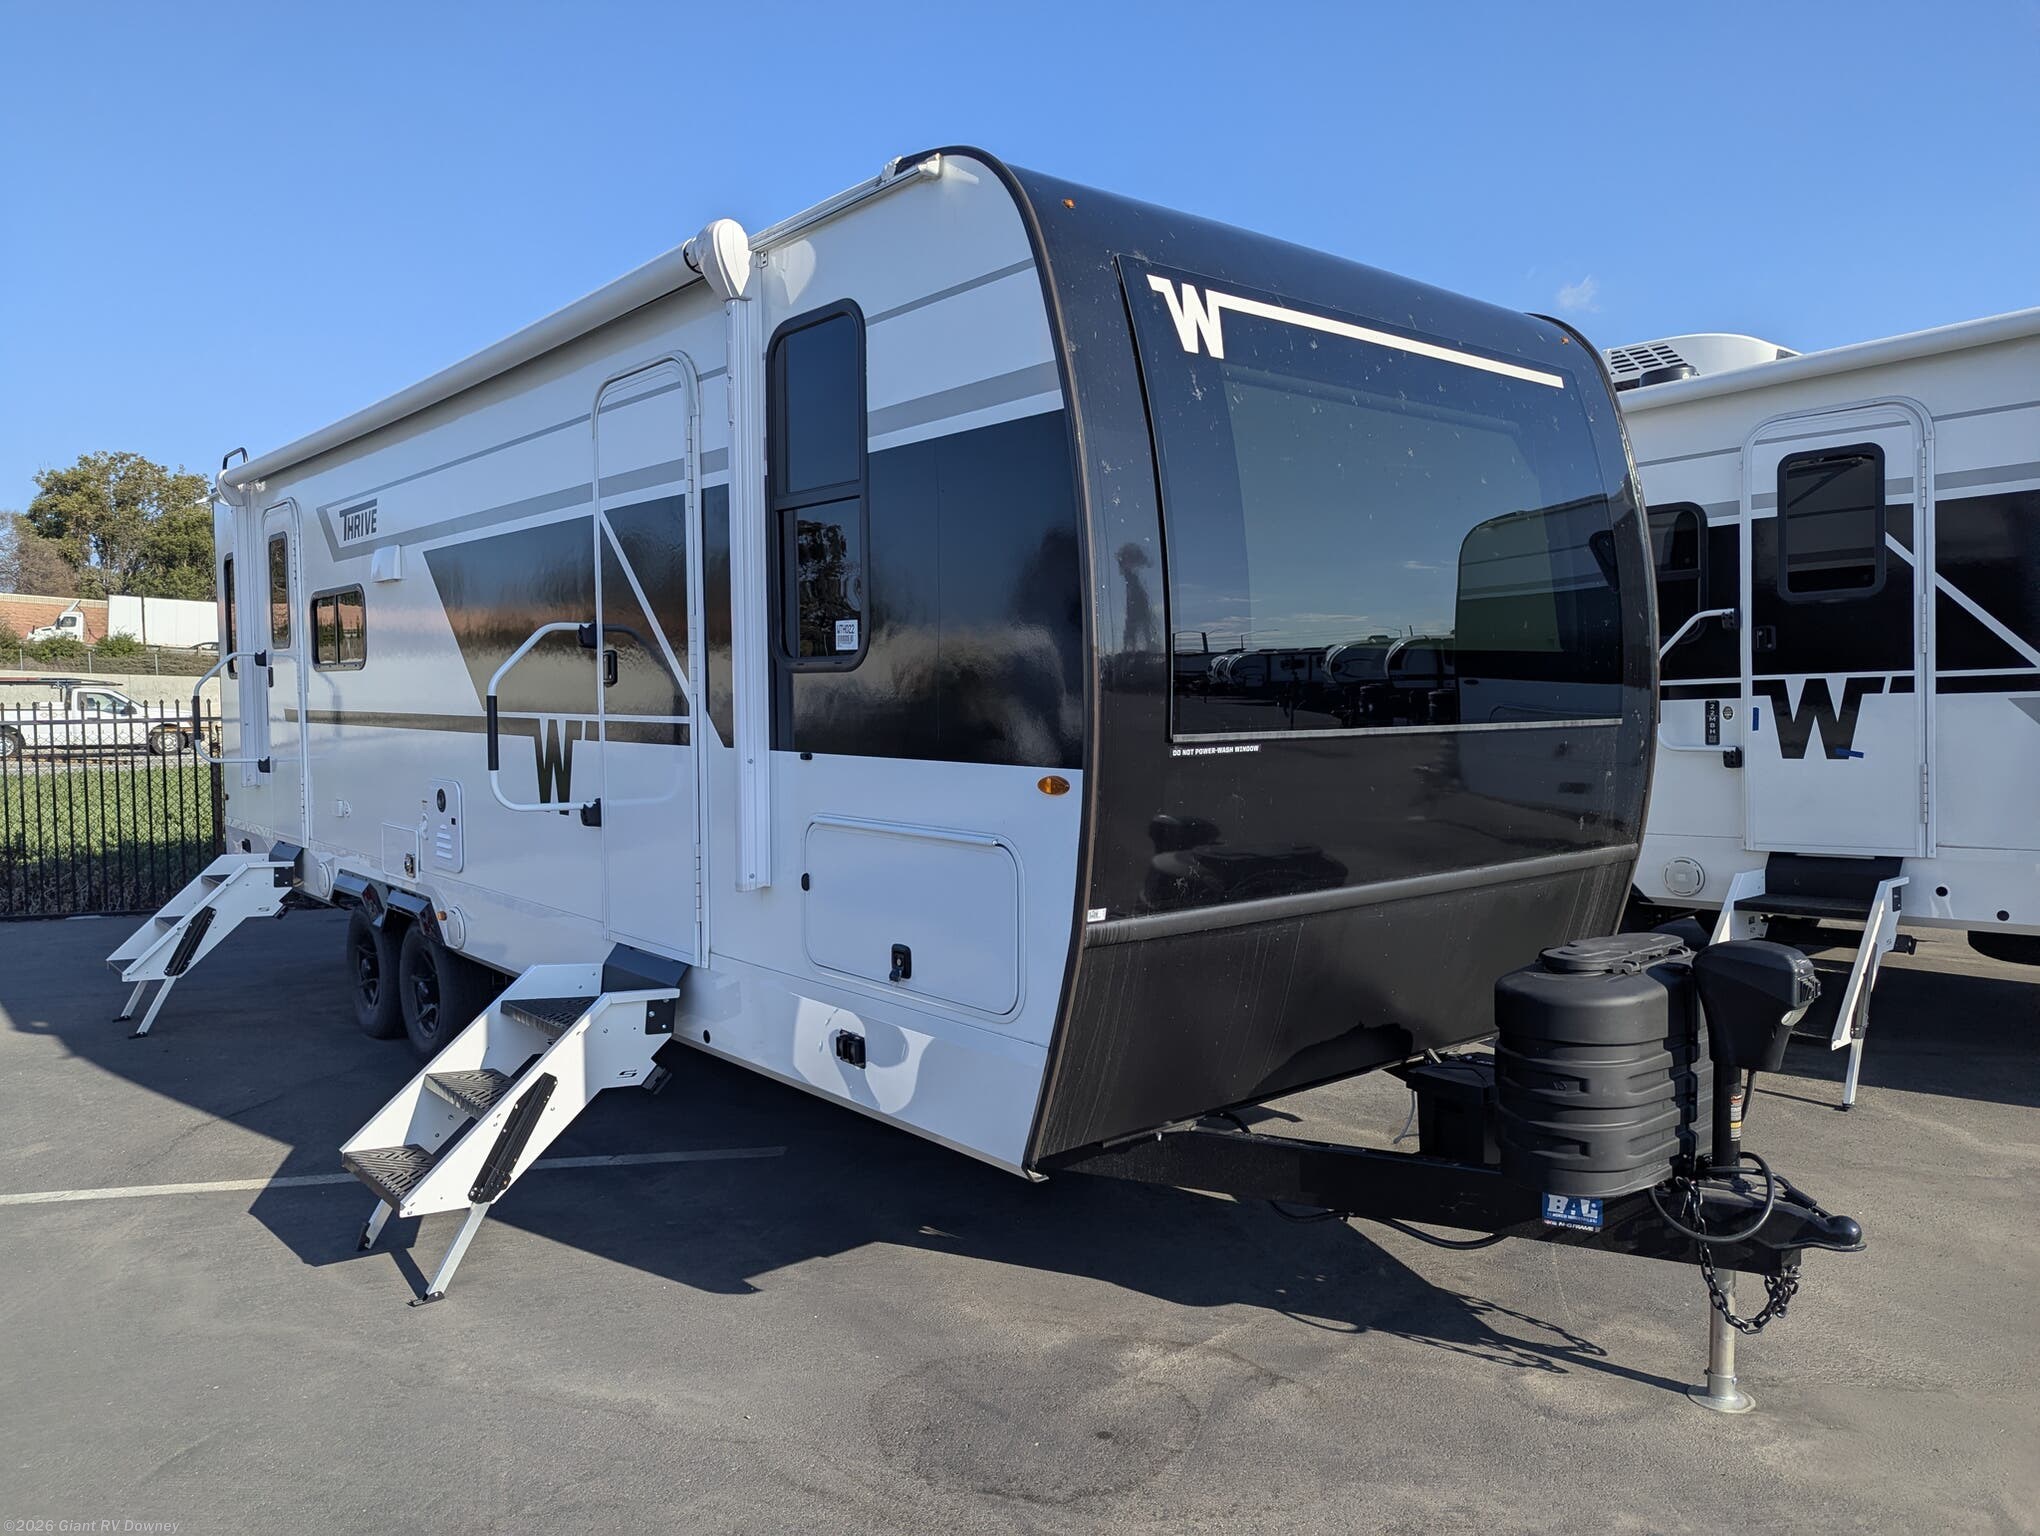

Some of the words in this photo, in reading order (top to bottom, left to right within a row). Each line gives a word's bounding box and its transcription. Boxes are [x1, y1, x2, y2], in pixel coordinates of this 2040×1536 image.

[339, 498, 378, 541] THRIVE
[1182, 748, 1194, 756] NOT
[1195, 746, 1234, 755] POWER-WASH
[1234, 745, 1260, 753] WINDOW
